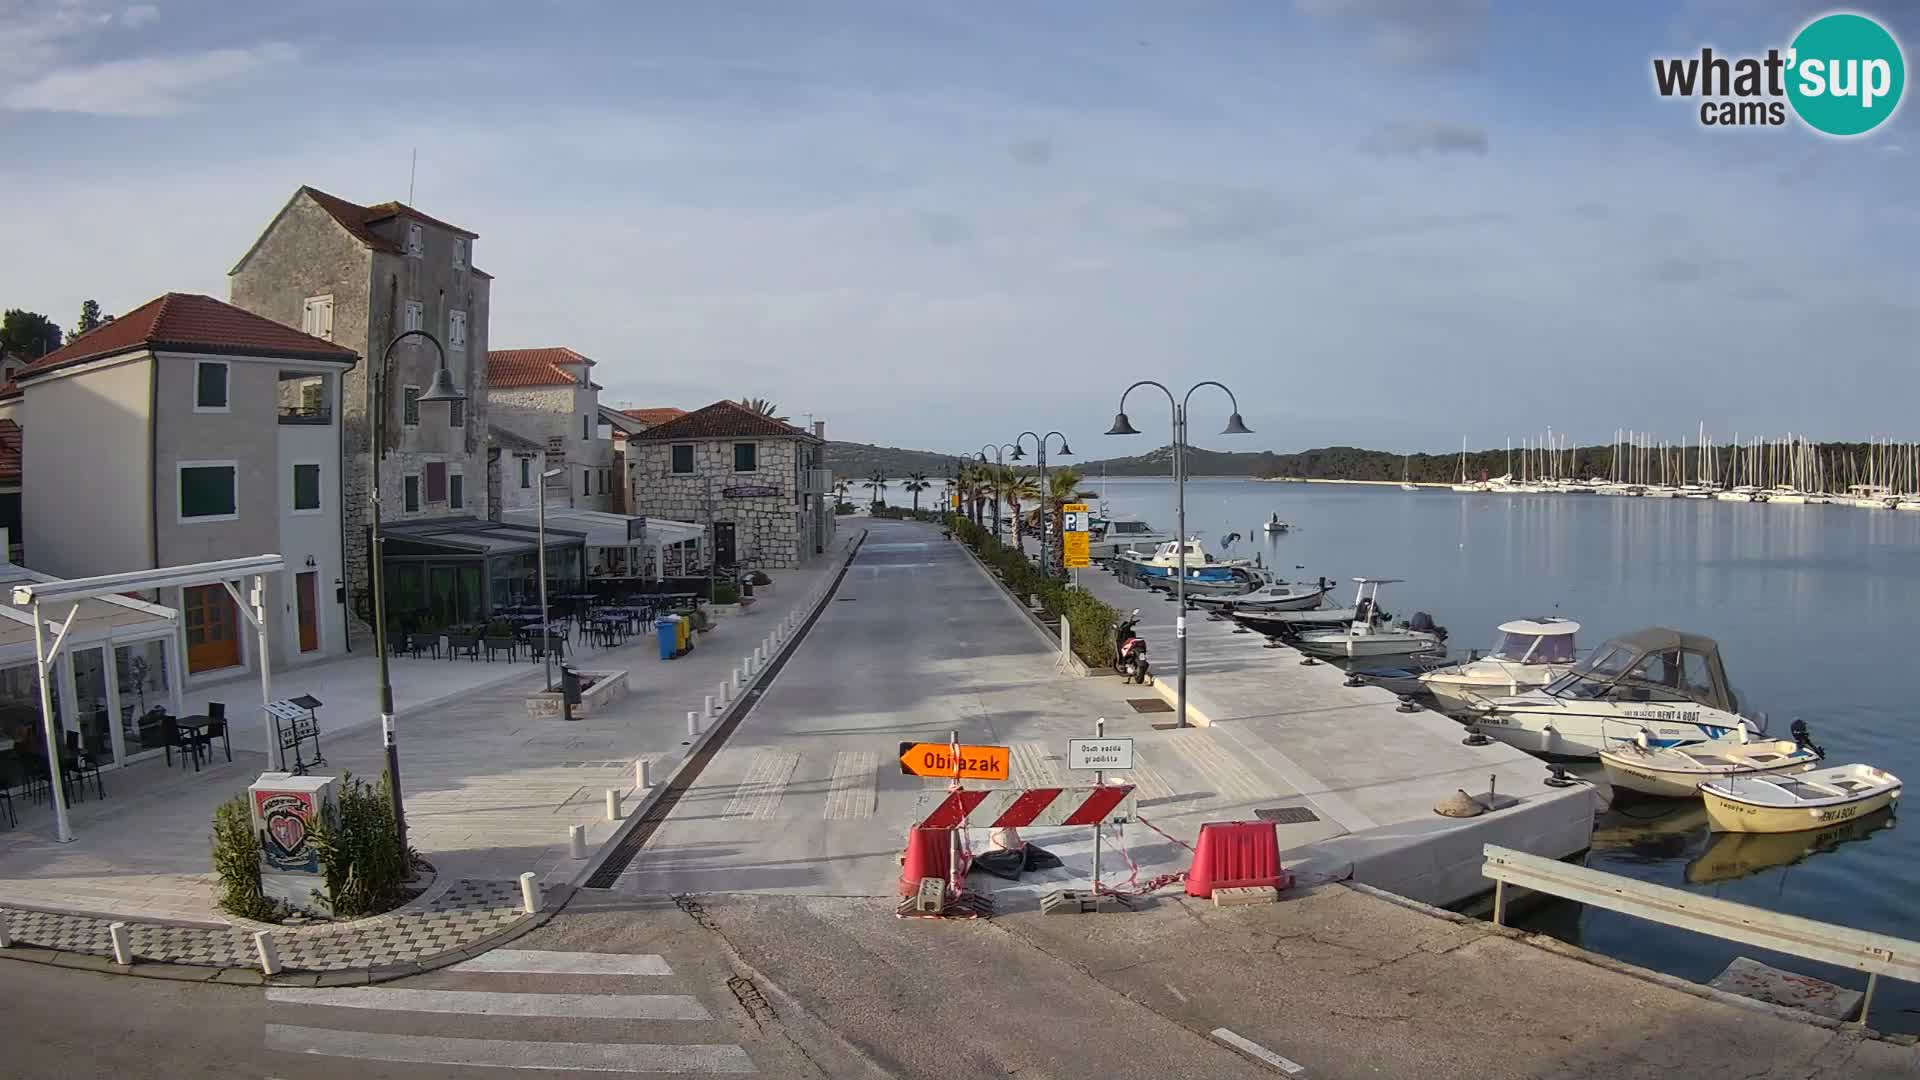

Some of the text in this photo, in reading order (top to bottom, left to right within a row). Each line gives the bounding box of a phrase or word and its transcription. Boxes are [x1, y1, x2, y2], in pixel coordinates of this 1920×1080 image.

[1657, 711, 1675, 720] RENT
[1676, 711, 1681, 719] A
[1682, 711, 1700, 722] BOAT
[924, 751, 1000, 772] Obiazak
